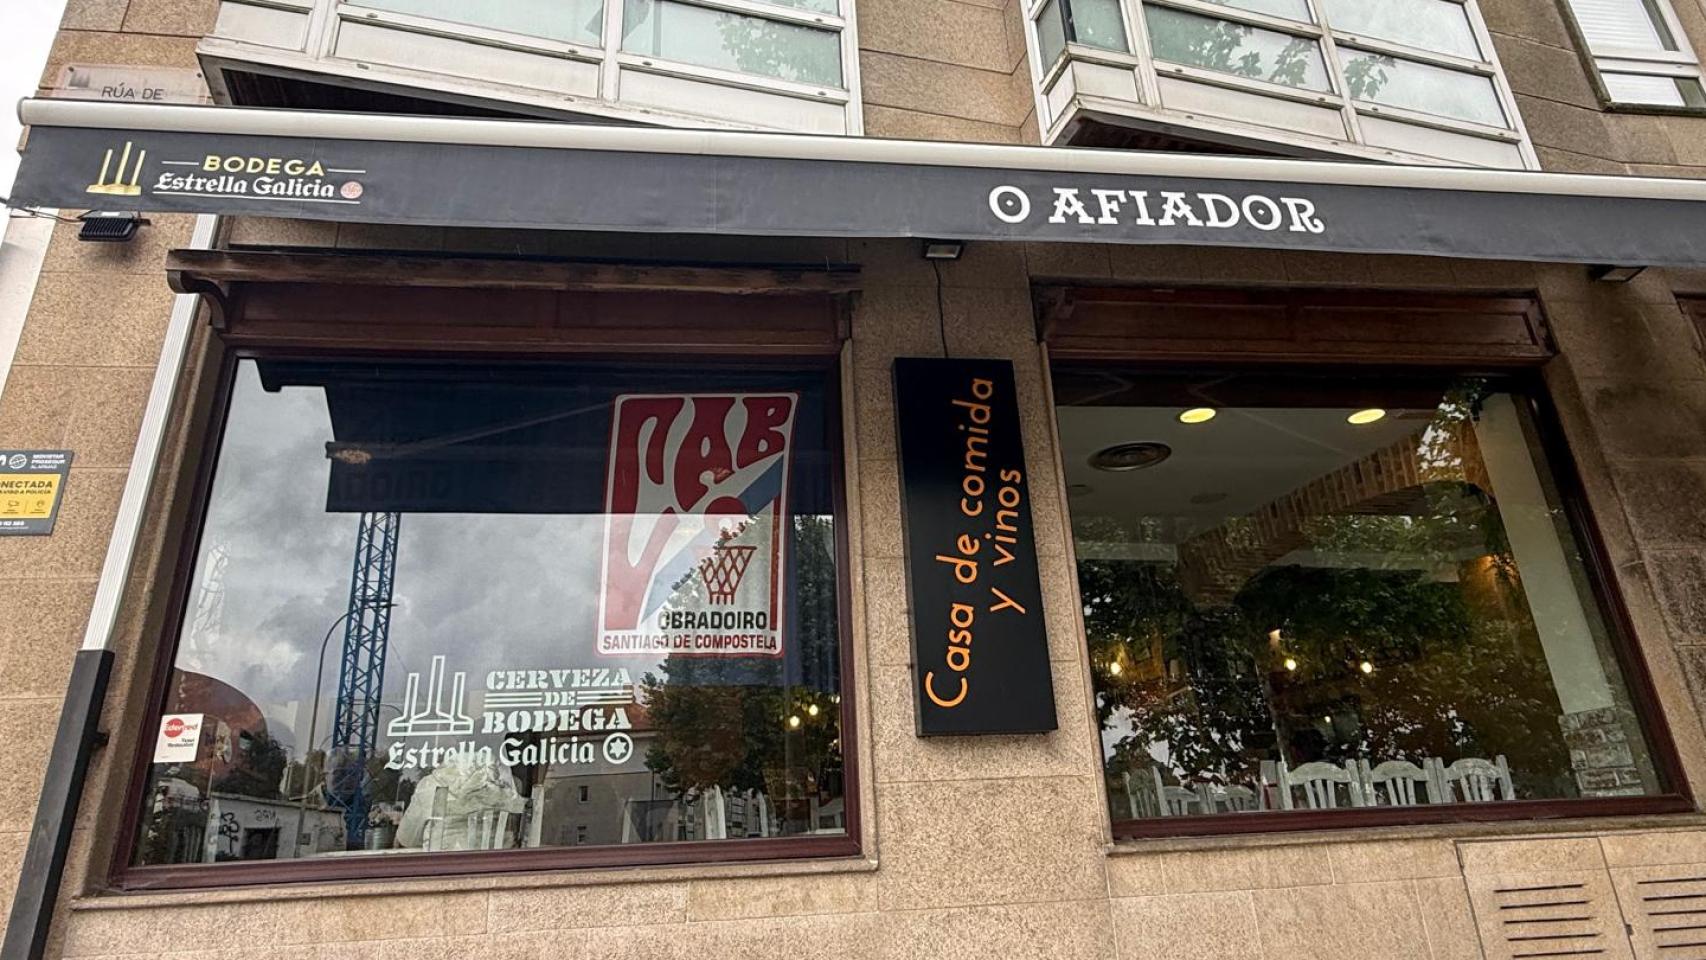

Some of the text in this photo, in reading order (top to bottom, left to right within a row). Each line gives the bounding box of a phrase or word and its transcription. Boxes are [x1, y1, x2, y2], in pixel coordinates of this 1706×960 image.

[101, 82, 165, 100] RÚA DE
[202, 154, 326, 177] BODEGA
[152, 171, 335, 198] Estrella Galicia
[988, 185, 1326, 235] O AFIADOR
[0, 480, 53, 489] NECTADA
[925, 378, 994, 708] Casa de comida
[984, 468, 1026, 614] y vinos
[658, 610, 768, 631] OBRADOIRO
[602, 633, 777, 650] SANTIAGO DE COMPOSTELA
[486, 667, 633, 691] CERVEZA
[543, 691, 578, 706] DE
[481, 707, 633, 735] BODEGA
[383, 736, 596, 770] Estrella Galicia
